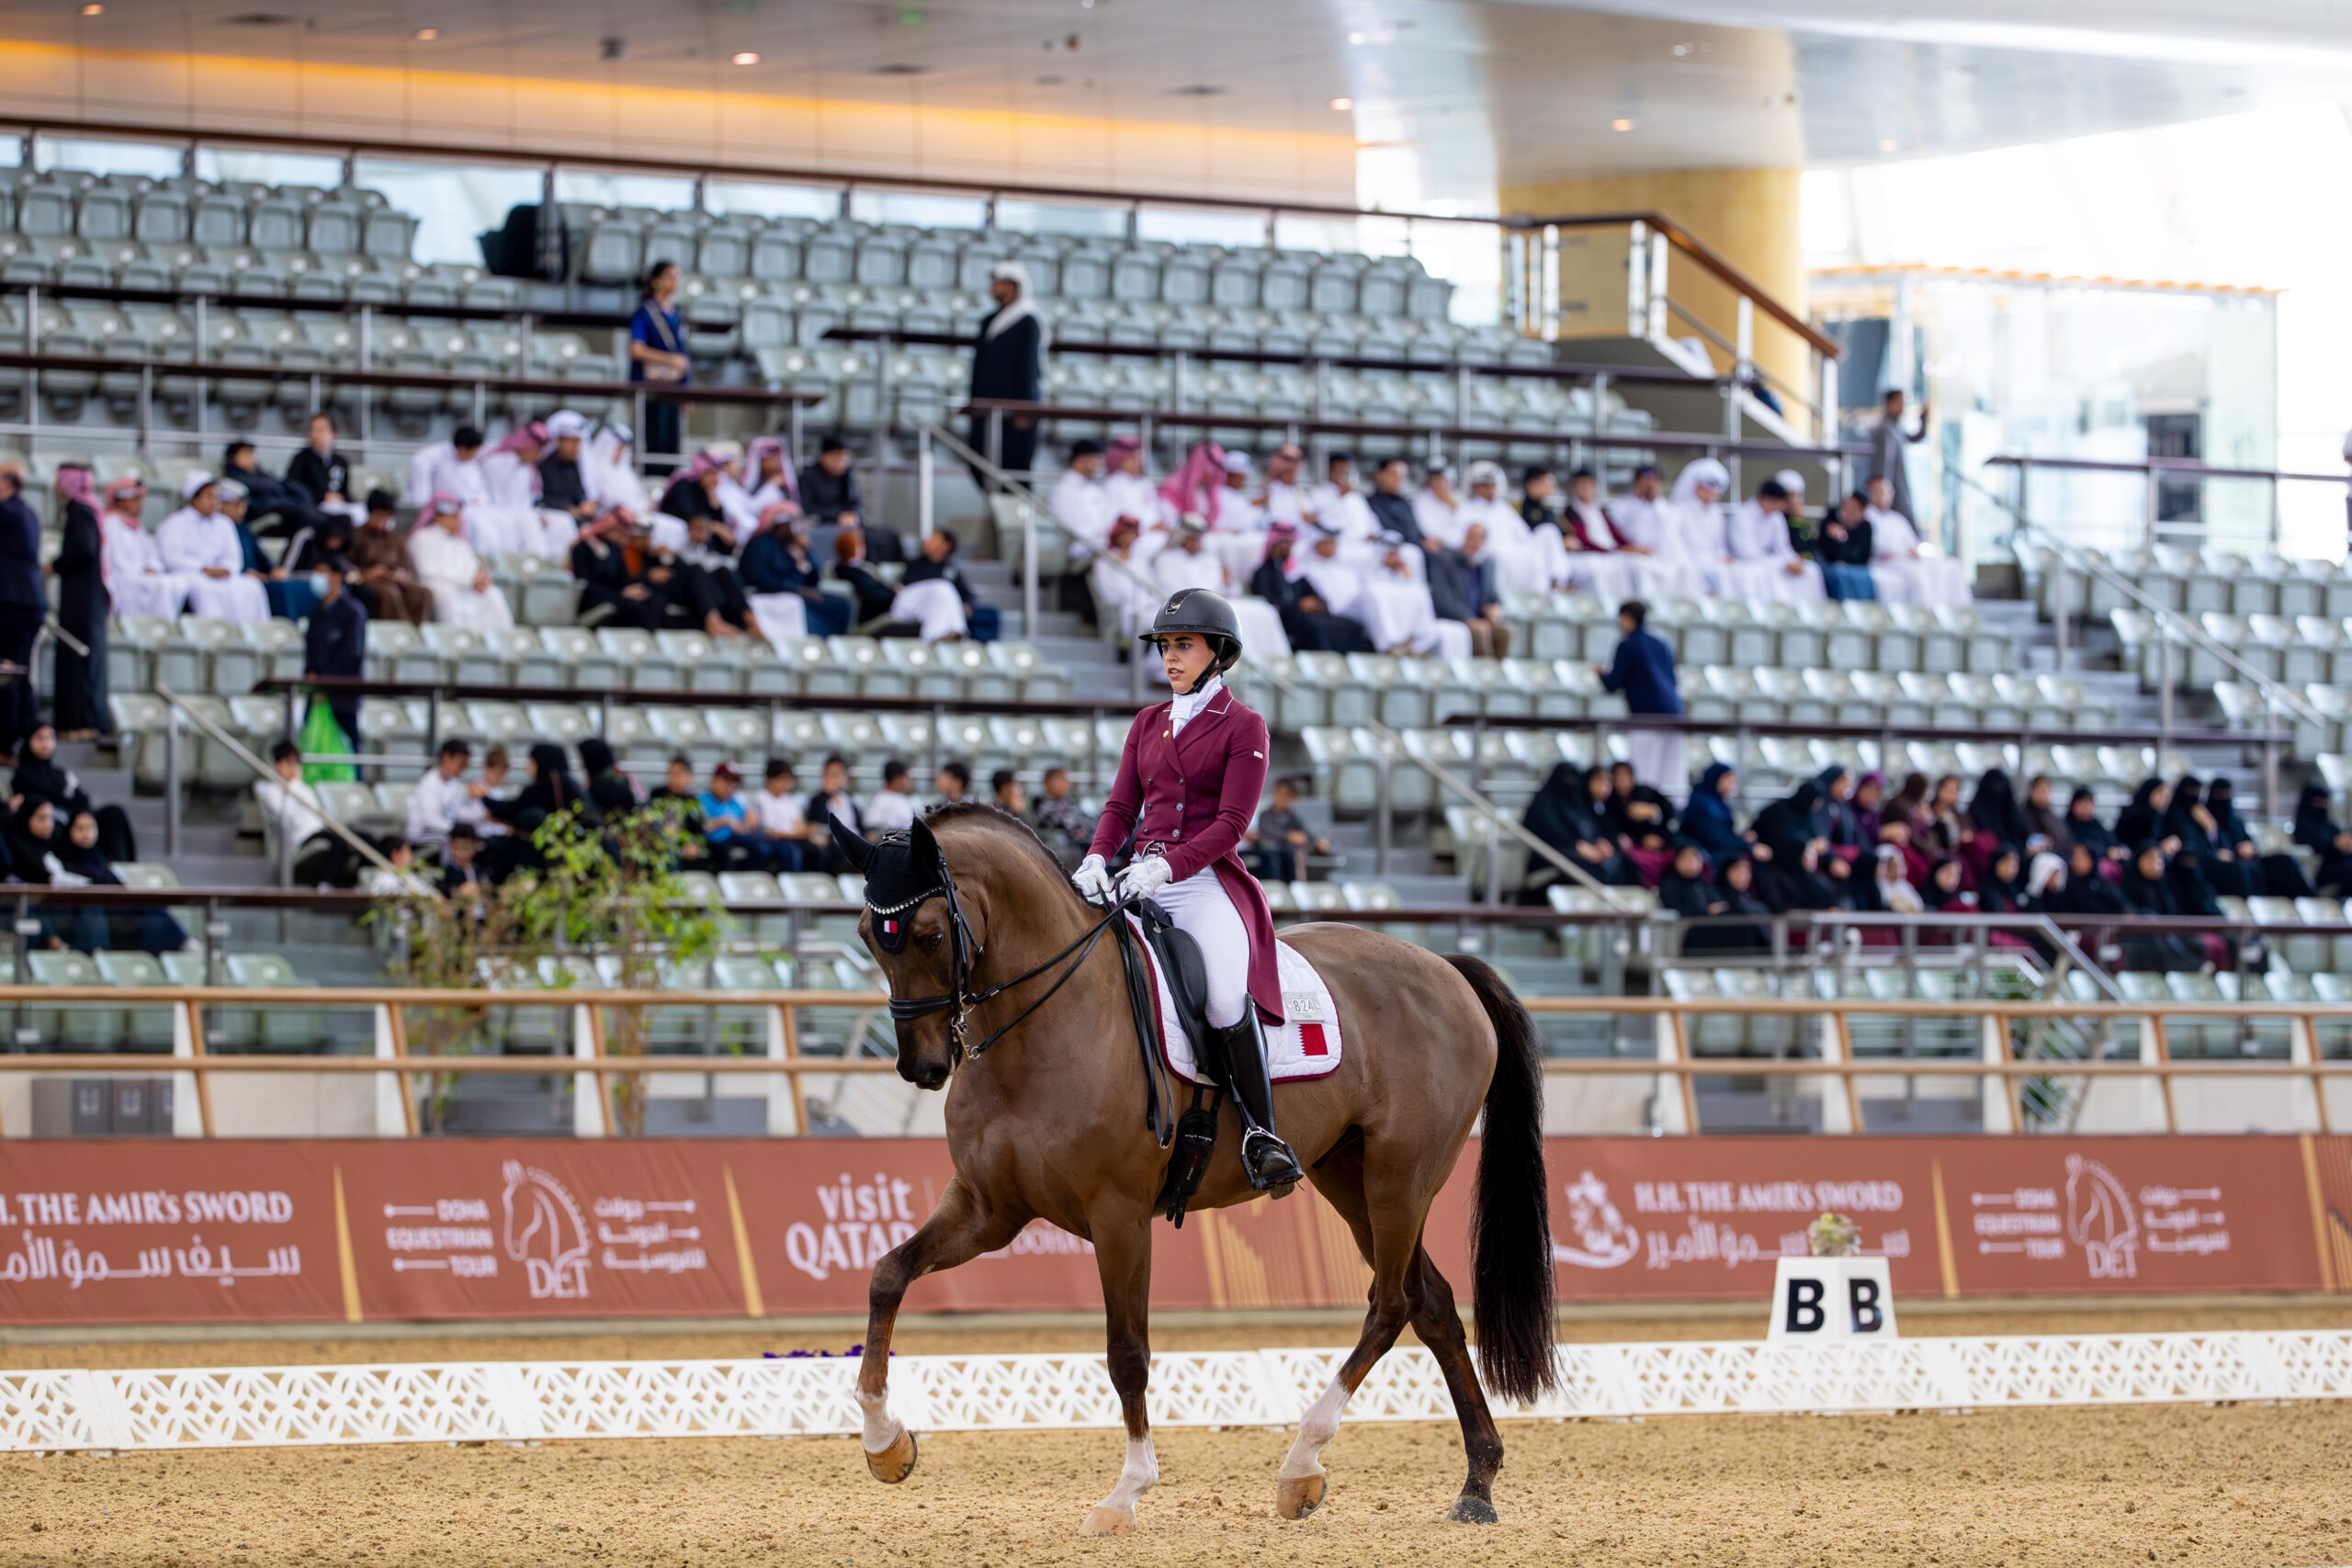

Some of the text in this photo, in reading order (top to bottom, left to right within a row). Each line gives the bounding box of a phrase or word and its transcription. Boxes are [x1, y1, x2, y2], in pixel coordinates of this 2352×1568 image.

[1293, 999, 1315, 1012] 824
[16, 1192, 82, 1224] THE
[184, 1190, 293, 1224] SWORD
[436, 1198, 491, 1222] DOHA
[816, 1172, 915, 1222] visit
[1682, 1181, 1736, 1213] THE
[1815, 1179, 1904, 1213] SWORD
[385, 1226, 494, 1252] EQUESTRIAN
[448, 1255, 499, 1278] TOUR
[525, 1256, 591, 1298] DET
[1786, 1279, 1826, 1333] B
[1849, 1279, 1883, 1333] B
